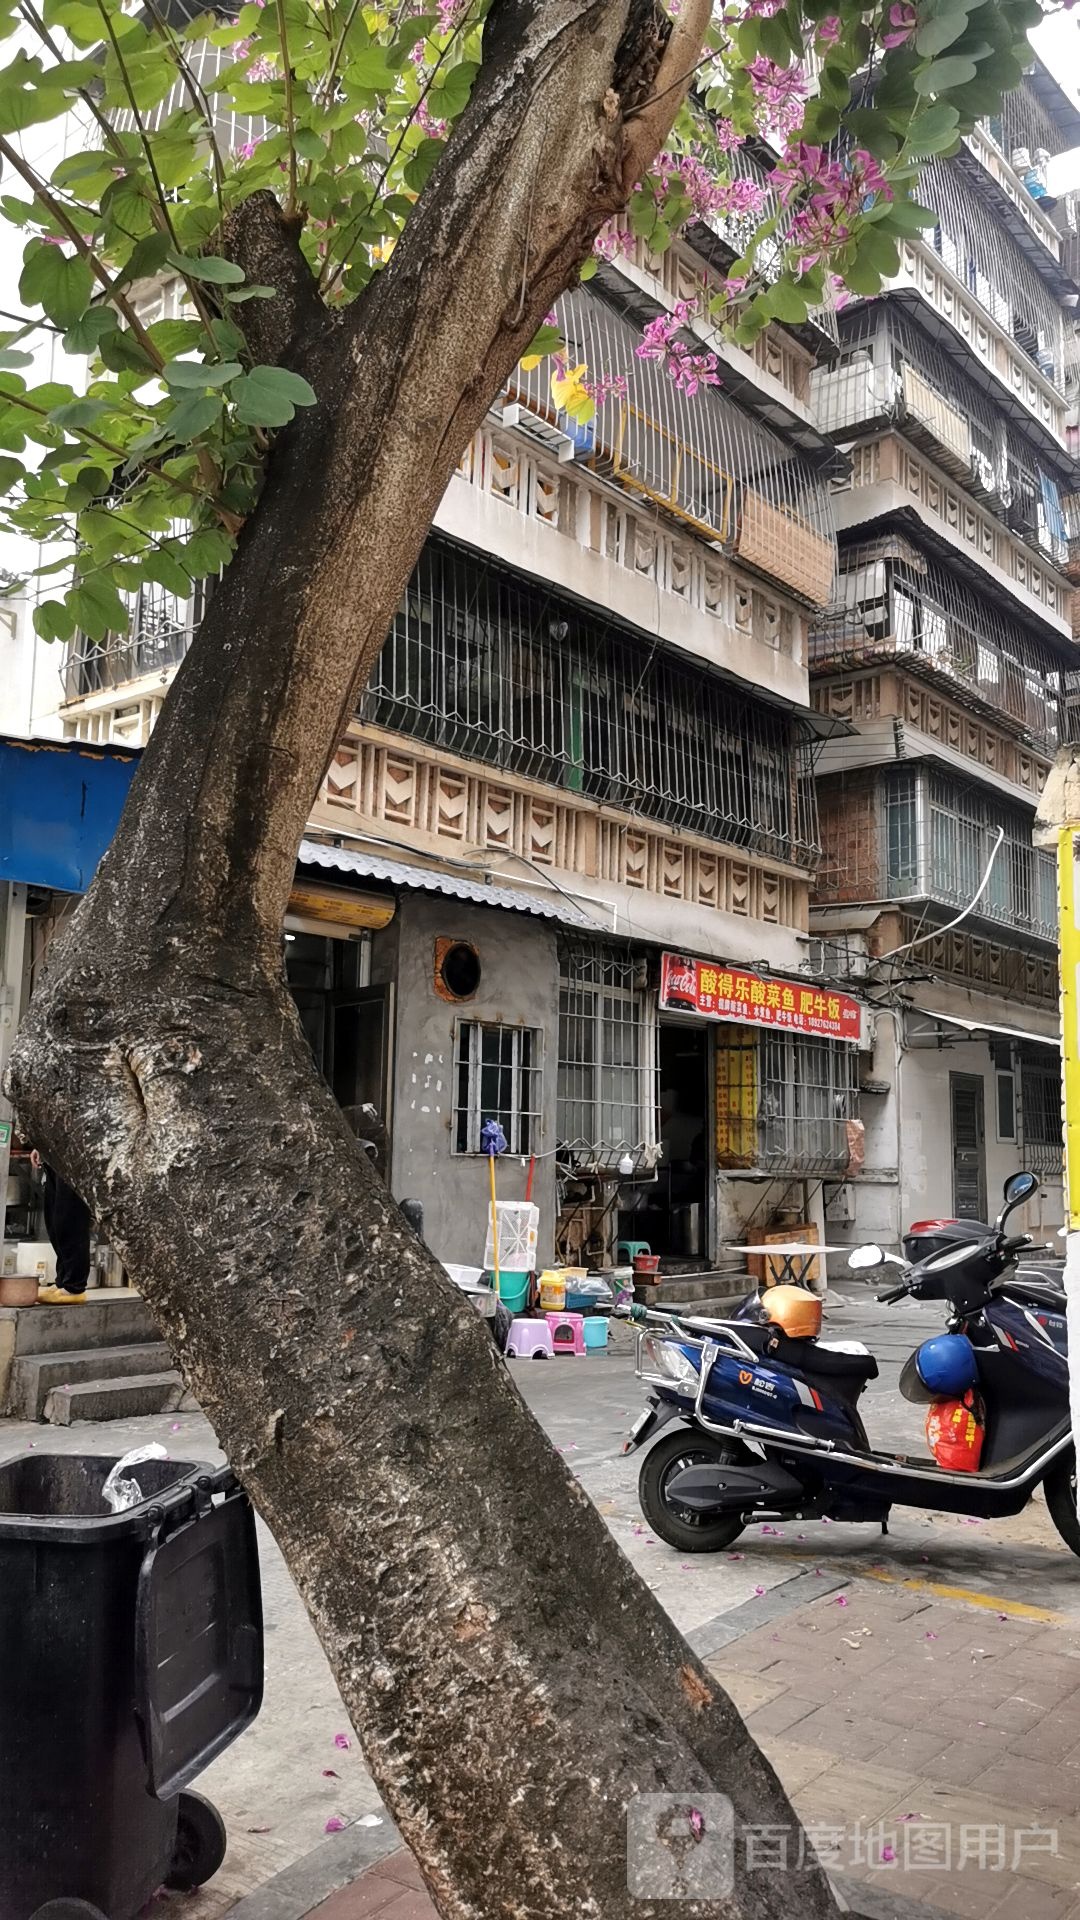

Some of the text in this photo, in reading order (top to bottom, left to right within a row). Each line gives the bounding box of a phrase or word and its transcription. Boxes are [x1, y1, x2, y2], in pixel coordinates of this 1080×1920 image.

[700, 967, 840, 1020] 酸得乐酸菜鱼 肥牛饭
